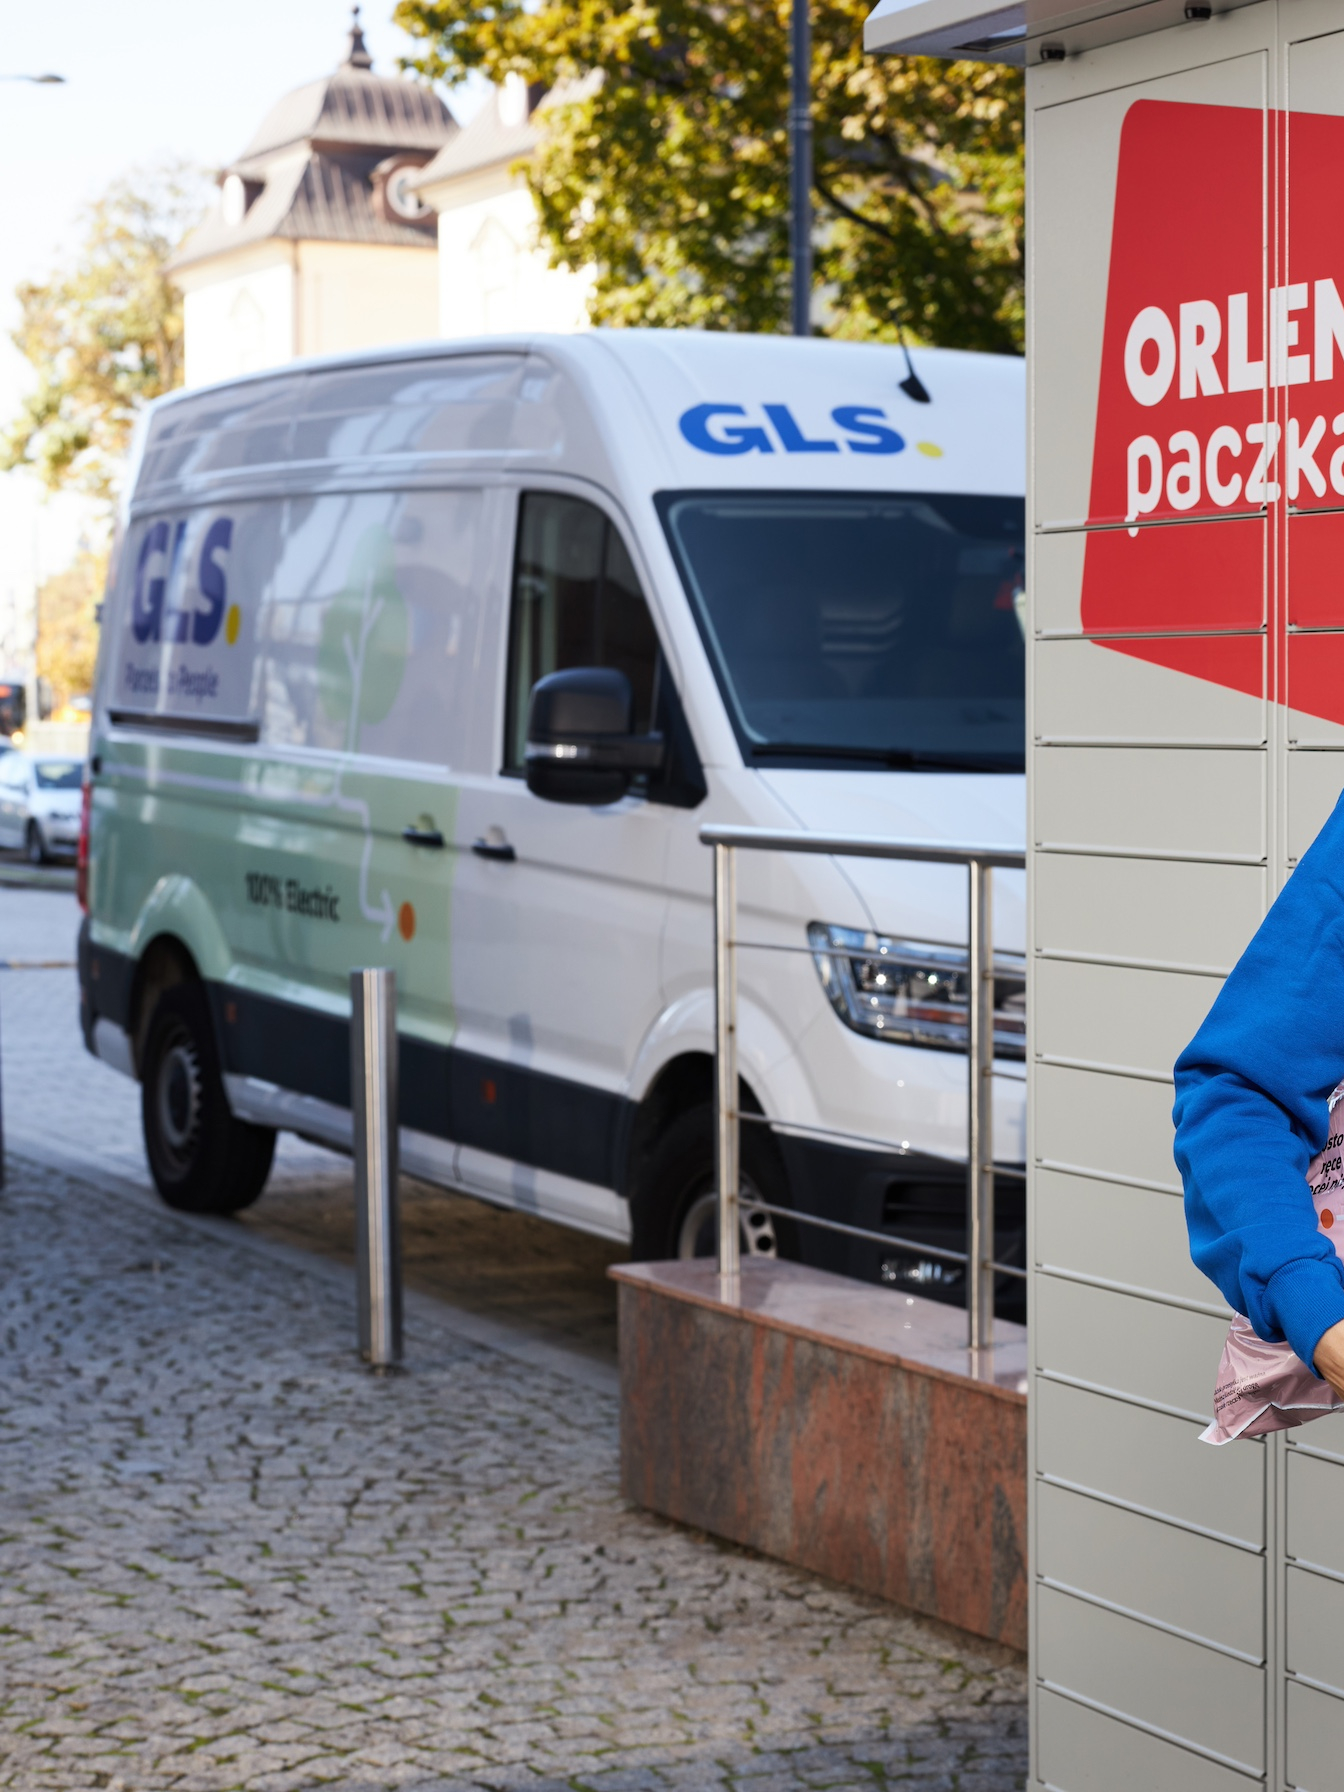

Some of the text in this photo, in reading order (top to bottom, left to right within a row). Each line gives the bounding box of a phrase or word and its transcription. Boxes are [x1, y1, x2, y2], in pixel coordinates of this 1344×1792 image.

[245, 872, 340, 922] 100% Electric
[1320, 1155, 1342, 1177] ręce
